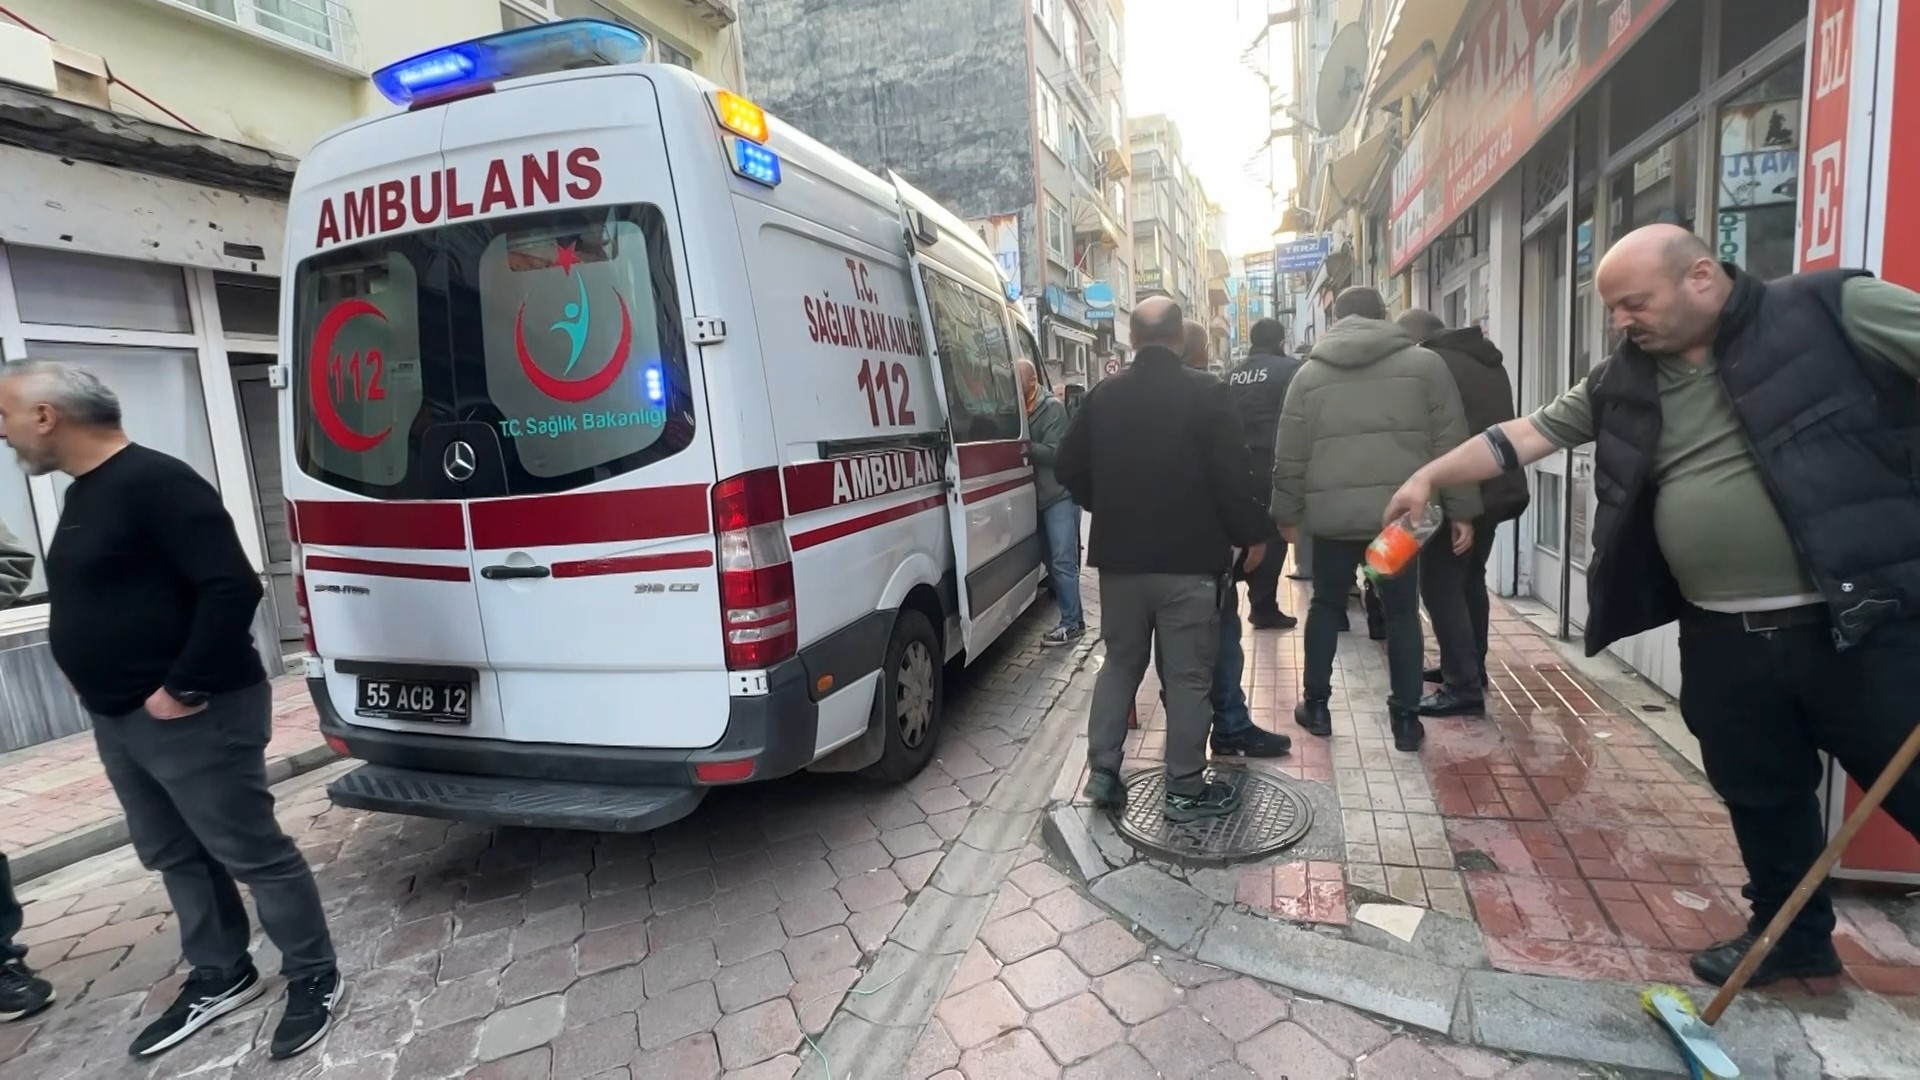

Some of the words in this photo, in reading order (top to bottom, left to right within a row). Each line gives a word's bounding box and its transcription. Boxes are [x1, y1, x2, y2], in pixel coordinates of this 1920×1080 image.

[1817, 8, 1848, 99] EL
[316, 147, 602, 249] AMBULANS
[845, 257, 879, 305] T.C.
[804, 290, 863, 349] SAĞLIK
[860, 308, 925, 357] BAKANLIĞI
[331, 347, 386, 404] 112
[858, 358, 915, 428] 112
[498, 418, 523, 437] T.C.
[526, 415, 578, 439] Sağlık
[582, 407, 667, 430] Bakanlığı
[833, 448, 940, 505] AMBULAN
[367, 682, 390, 708] 55
[396, 684, 435, 711] ACB
[442, 688, 466, 714] 12
